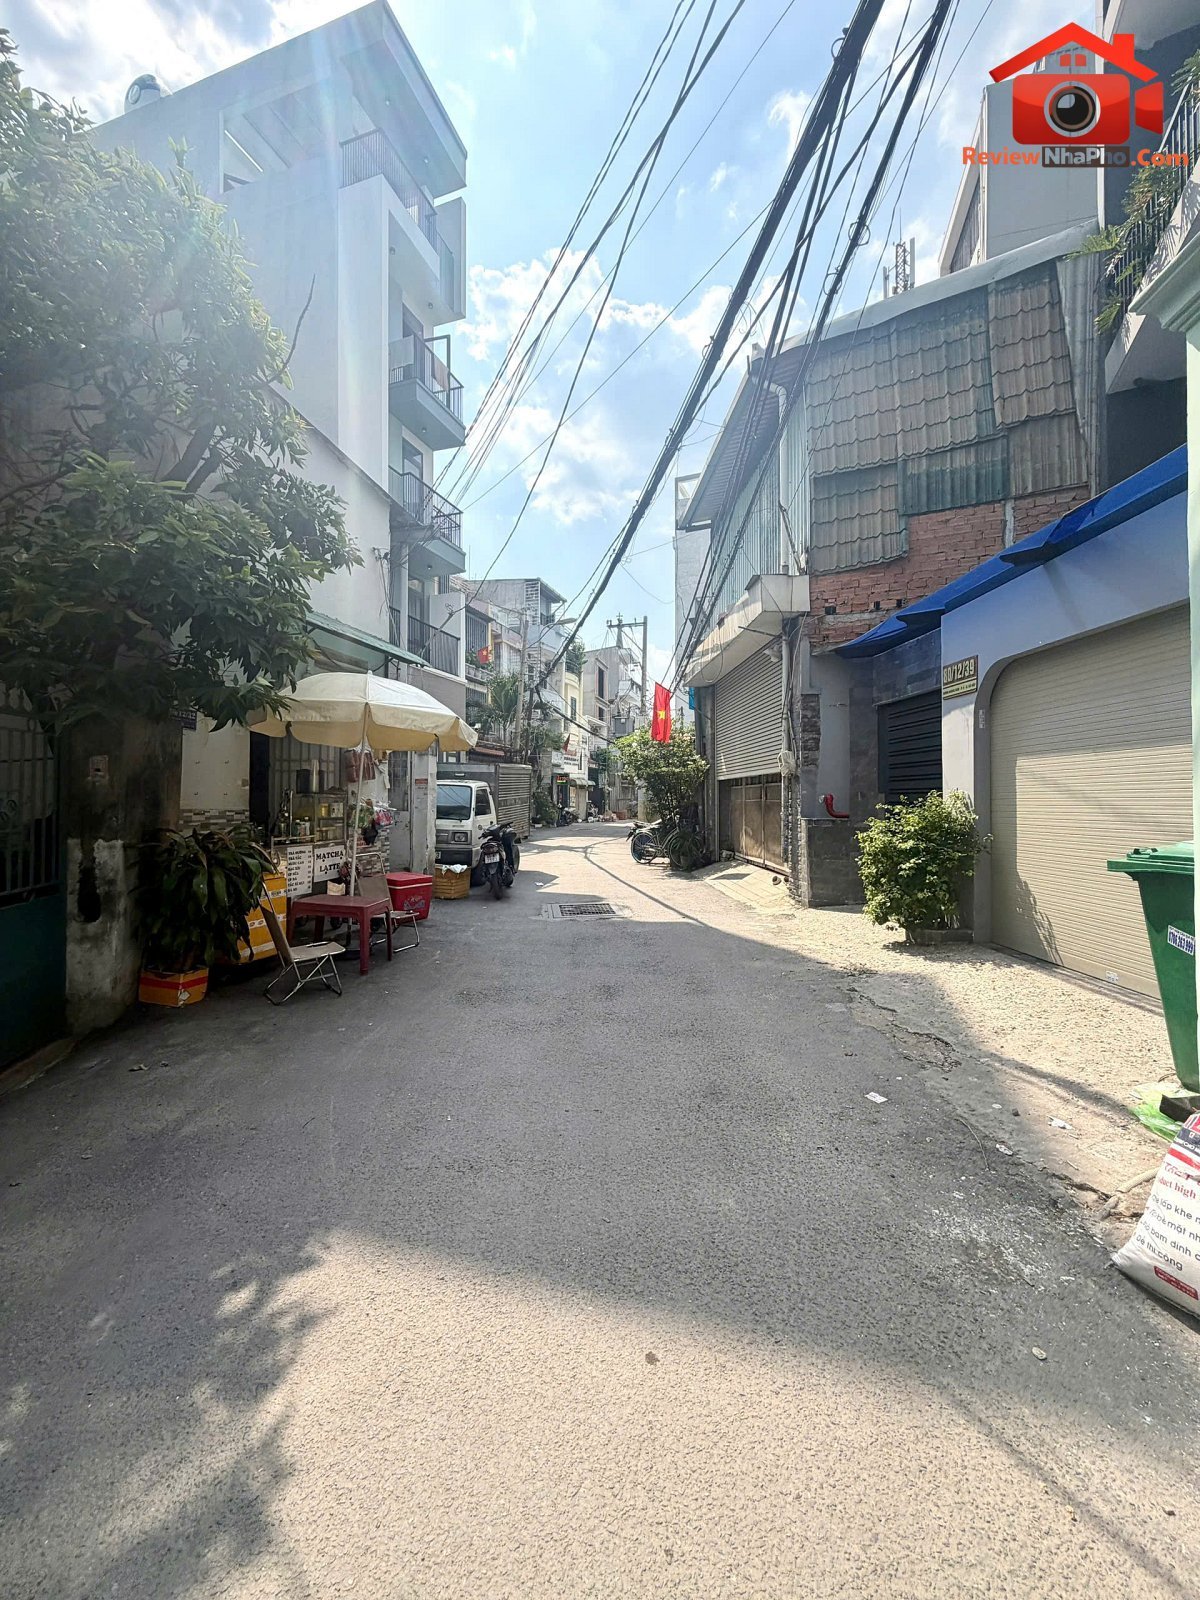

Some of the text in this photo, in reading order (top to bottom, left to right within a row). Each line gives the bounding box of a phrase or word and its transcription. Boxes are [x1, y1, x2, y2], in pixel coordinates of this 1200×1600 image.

[943, 659, 975, 683] 80/12/39
[316, 850, 344, 861] MATCHA
[1174, 1182, 1196, 1199] high
[1174, 1205, 1193, 1220] khe
